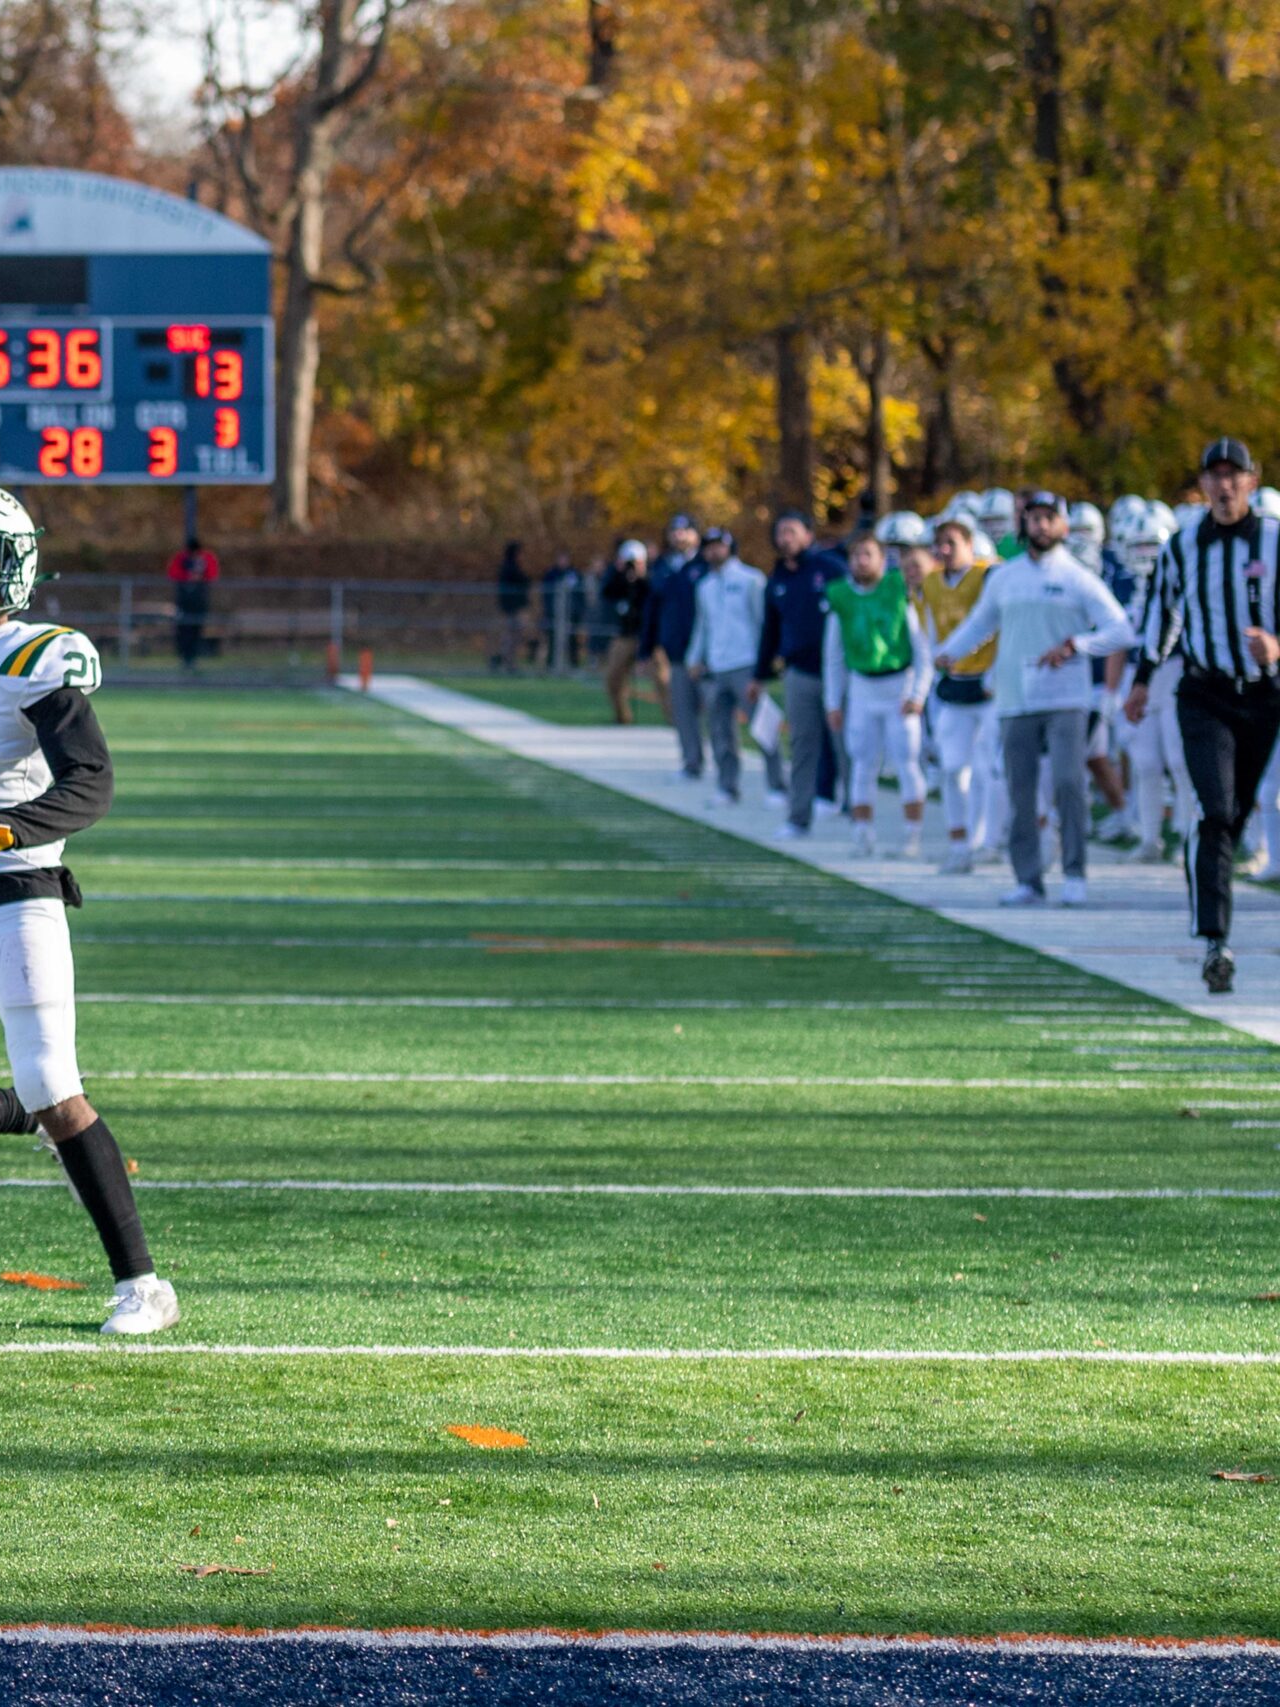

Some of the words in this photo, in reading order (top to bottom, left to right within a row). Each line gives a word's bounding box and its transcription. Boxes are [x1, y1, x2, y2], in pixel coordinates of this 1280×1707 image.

[195, 349, 243, 401] 13
[38, 425, 104, 478] 28
[148, 425, 178, 478] 3
[214, 406, 241, 449] 3
[63, 651, 97, 687] 21
